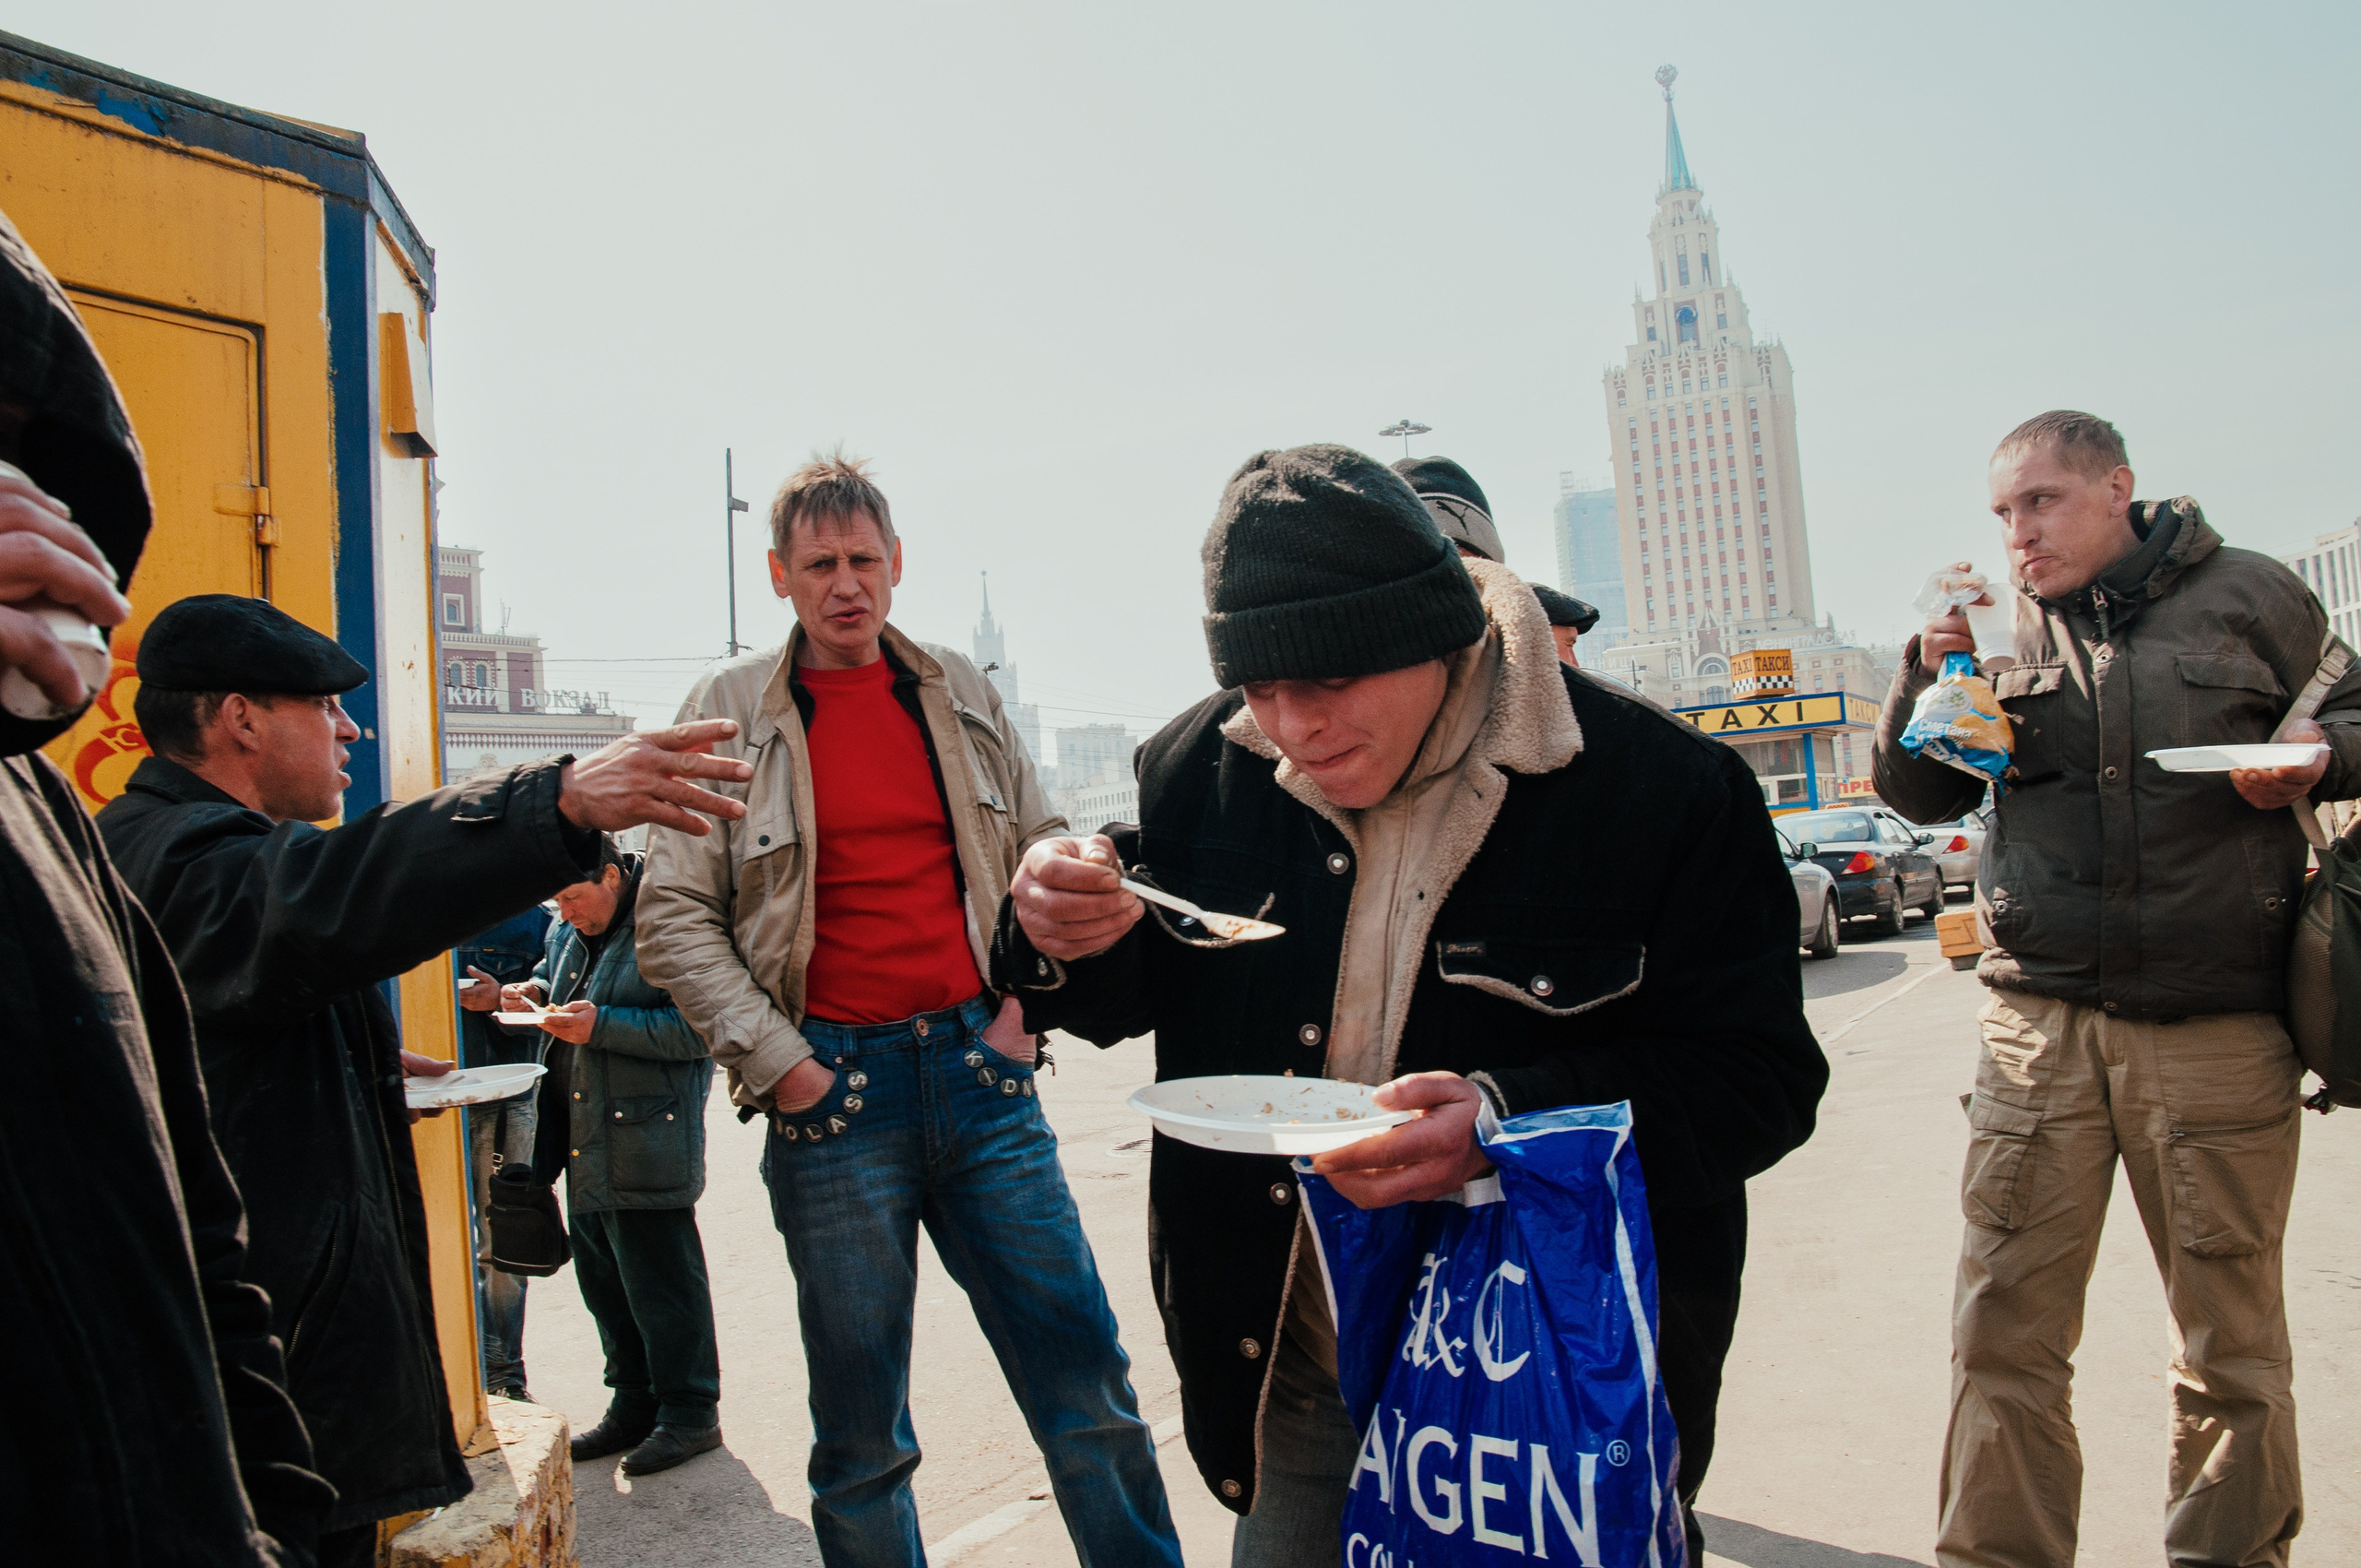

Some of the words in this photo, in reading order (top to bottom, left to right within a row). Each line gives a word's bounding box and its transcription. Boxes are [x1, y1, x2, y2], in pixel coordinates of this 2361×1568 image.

[1733, 658, 1753, 676] TAXI
[1755, 656, 1789, 671] ТАКСИ
[447, 682, 499, 706] КИЙ
[520, 688, 610, 708] ВОКЗАЛ
[1686, 701, 1804, 731] TAXI
[1918, 719, 1972, 740] Сметана
[1838, 779, 1879, 794] ПРЕ
